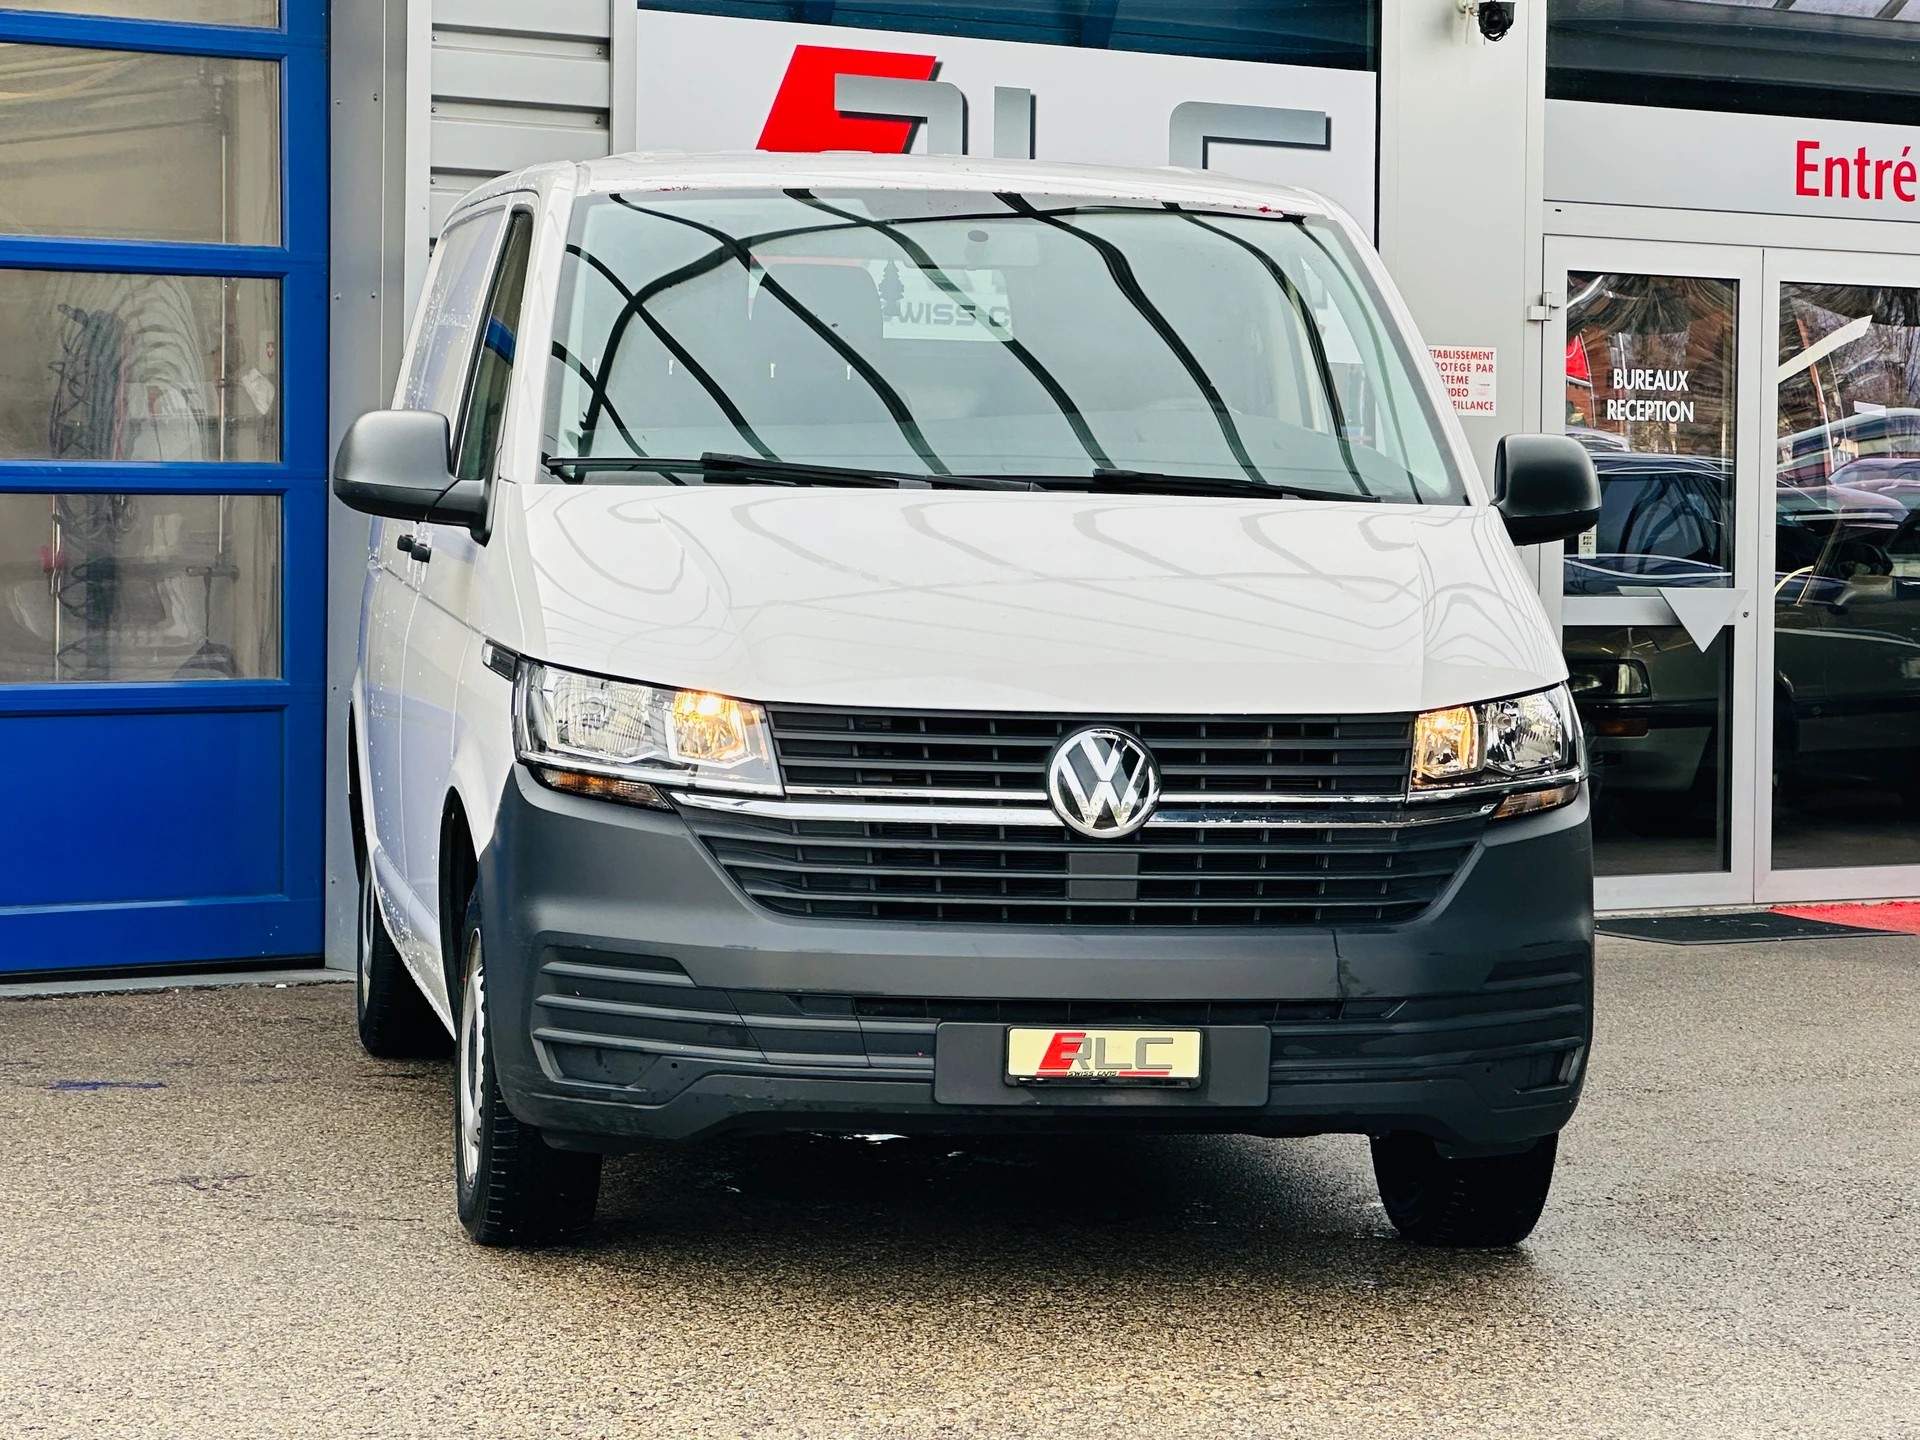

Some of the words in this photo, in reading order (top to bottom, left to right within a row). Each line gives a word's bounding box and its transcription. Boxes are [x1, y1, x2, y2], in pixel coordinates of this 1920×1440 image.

[884, 302, 977, 326] WISS
[1434, 360, 1471, 373] ROTÉGÉ
[1475, 363, 1494, 373] PAR
[1447, 385, 1469, 397] IDÉO
[1613, 368, 1689, 391] BUREAUX
[1453, 400, 1494, 411] EILLANCE
[1607, 399, 1694, 422] RECEPTION
[1053, 730, 1152, 834] VW
[1038, 1032, 1173, 1069] ERLC
